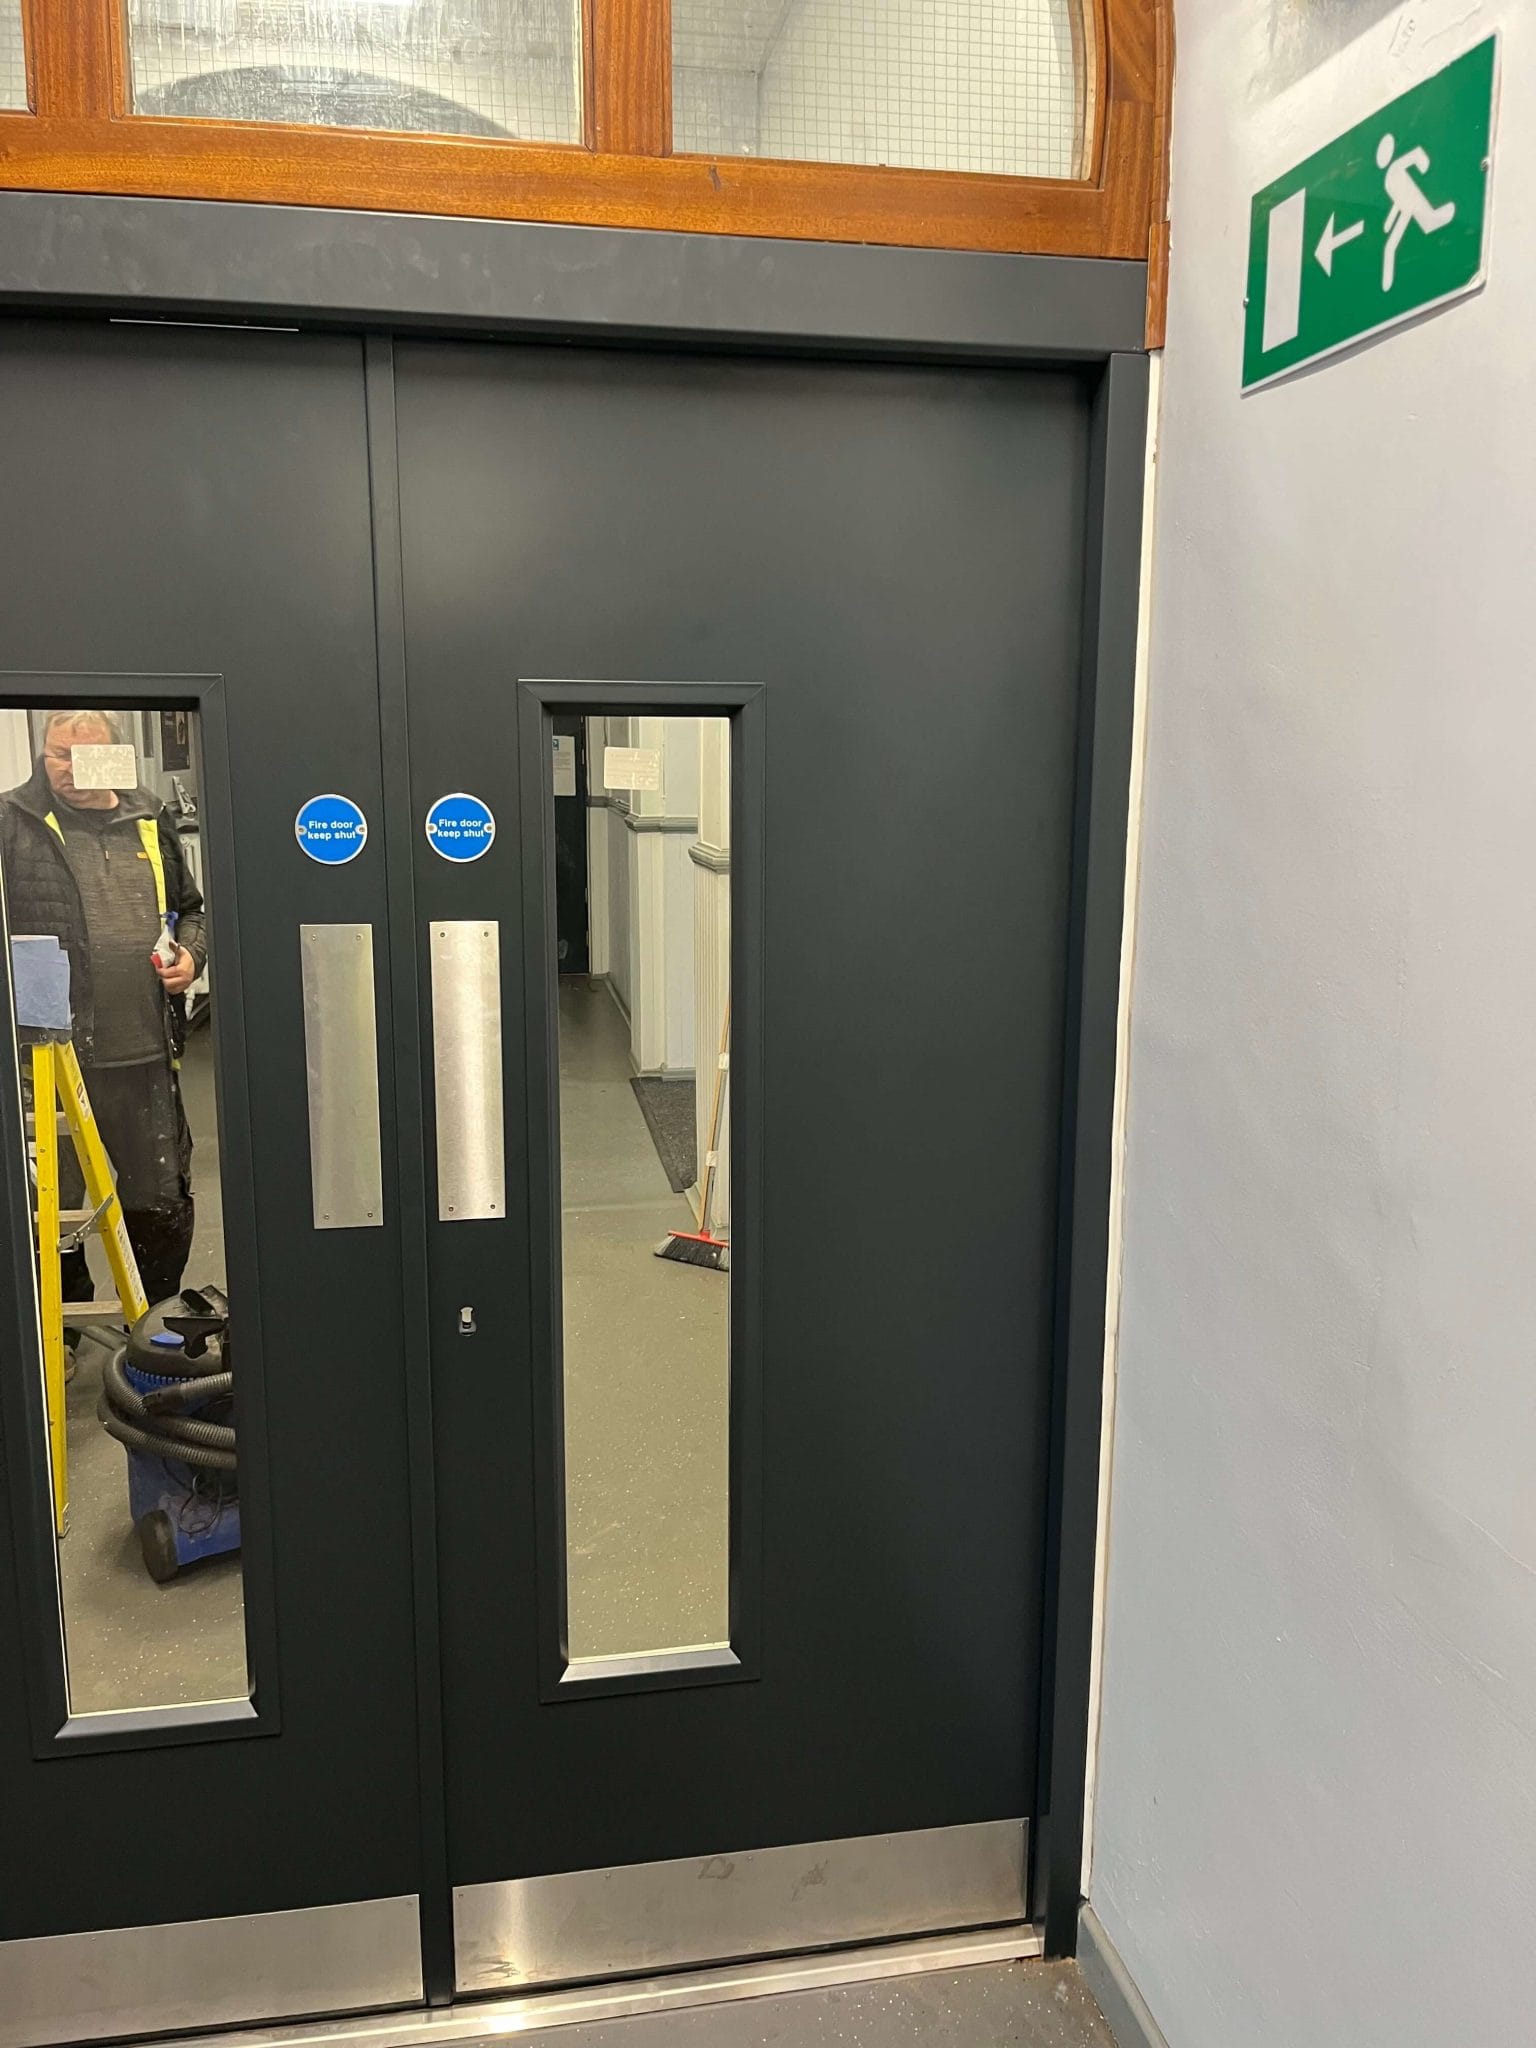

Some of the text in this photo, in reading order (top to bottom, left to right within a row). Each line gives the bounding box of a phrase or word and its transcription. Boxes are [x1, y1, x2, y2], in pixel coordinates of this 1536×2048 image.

[308, 820, 353, 829] Fire door
[438, 818, 482, 827] Fire door
[307, 831, 356, 841] keep shut
[437, 829, 484, 839] keep shut
